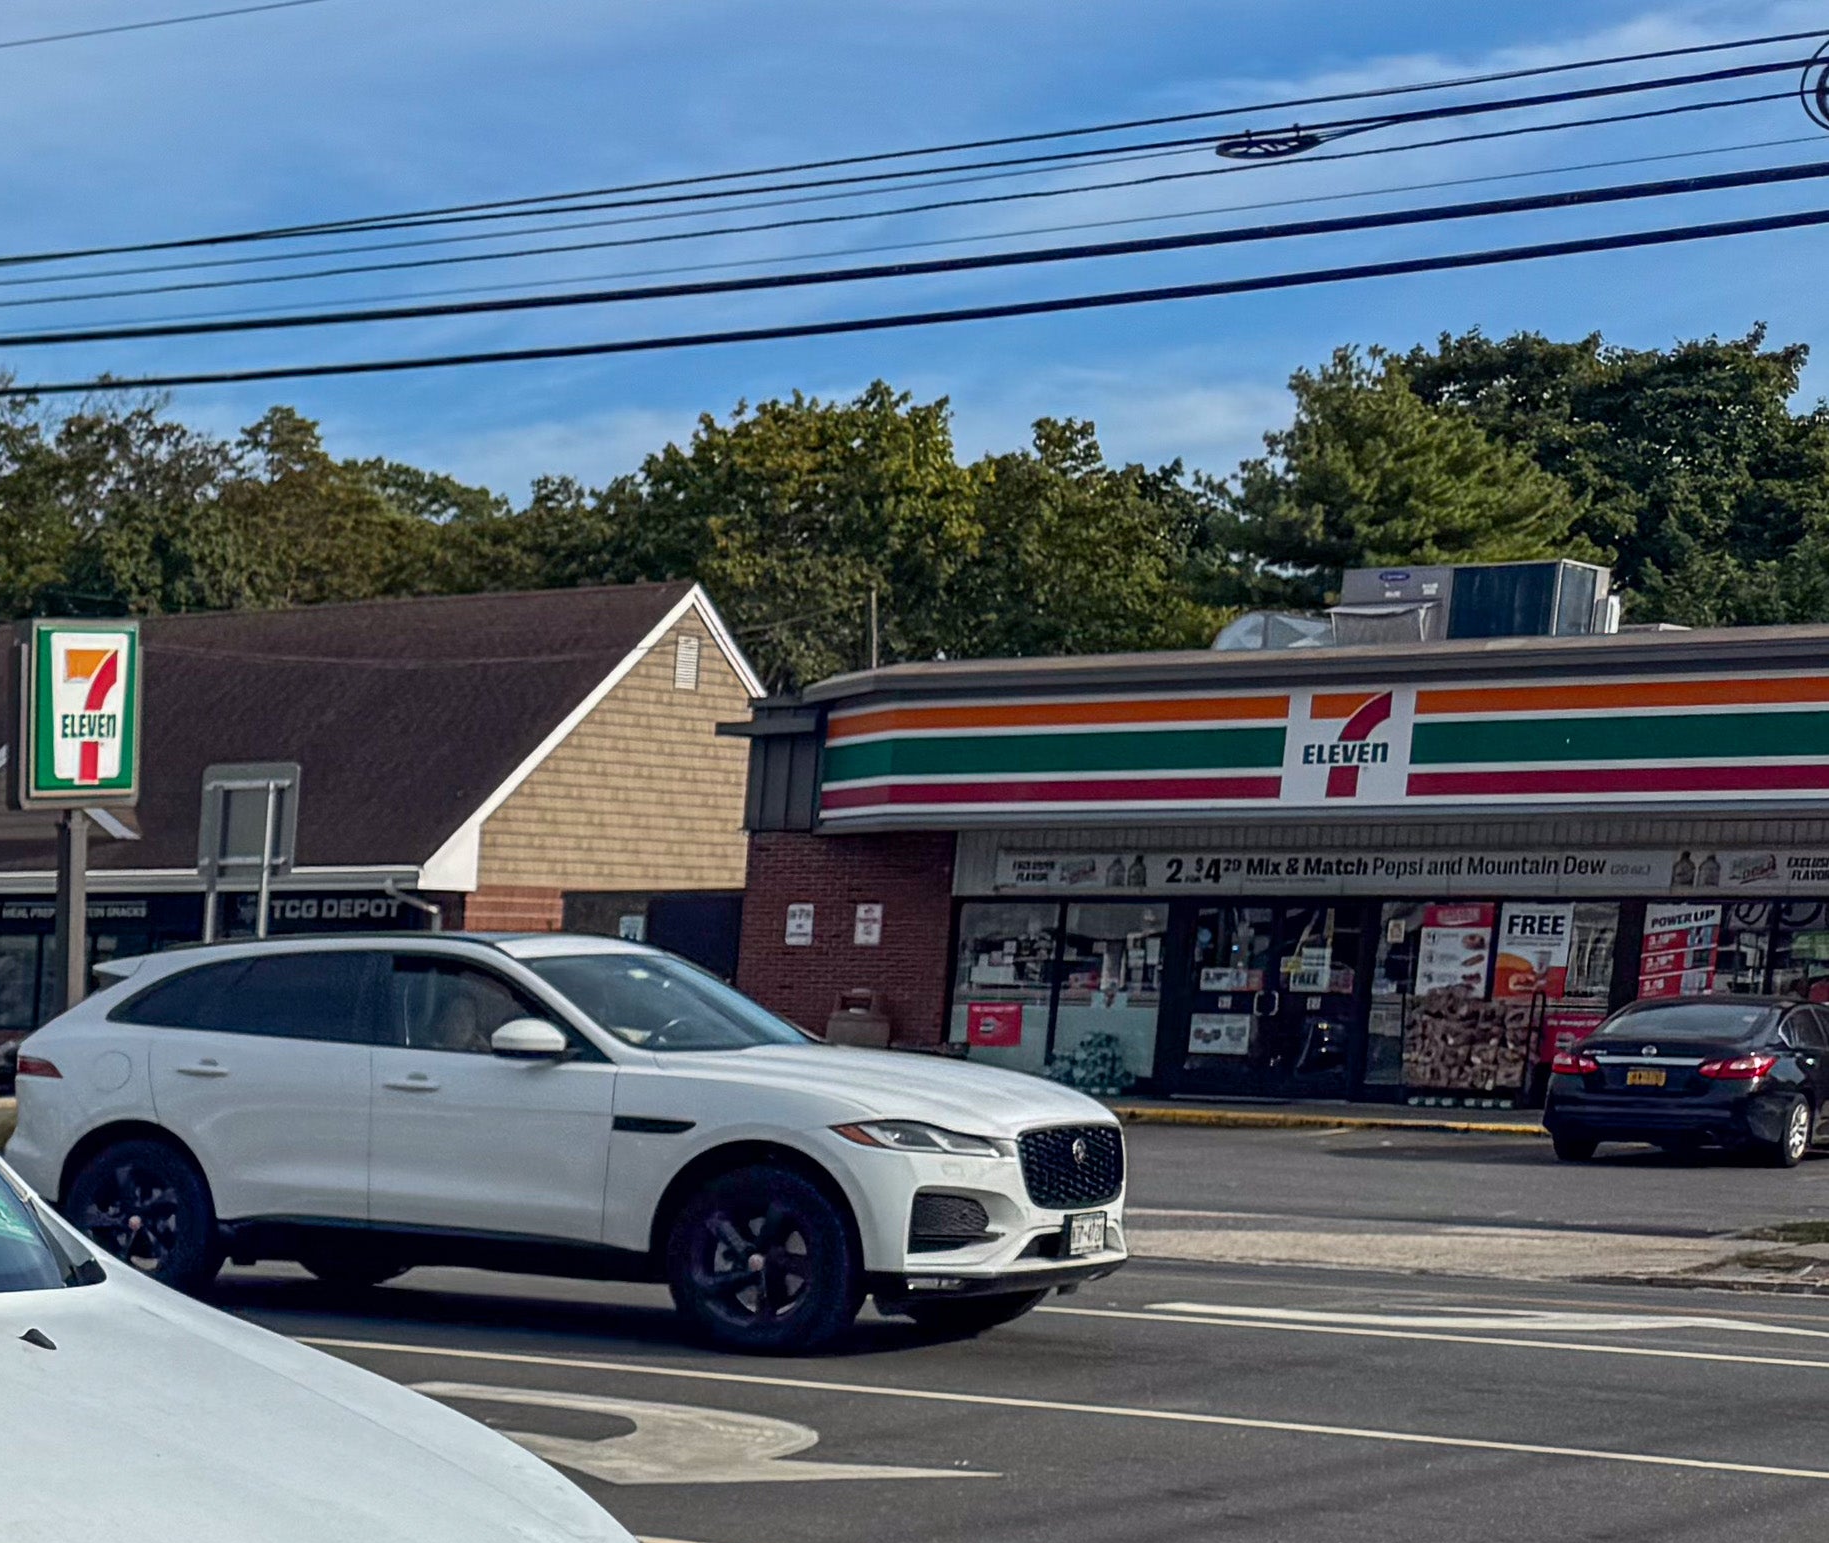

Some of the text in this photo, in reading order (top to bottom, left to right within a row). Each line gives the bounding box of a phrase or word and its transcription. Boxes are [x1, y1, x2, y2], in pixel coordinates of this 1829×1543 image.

[64, 649, 118, 781] 7
[1310, 690, 1392, 798] 7
[1166, 858, 1183, 883] 2
[1246, 857, 1282, 876] Mix
[1286, 857, 1299, 876] &
[1303, 856, 1369, 876] Match
[1373, 856, 1424, 879] Pepsi
[1427, 857, 1462, 876] and
[1467, 855, 1558, 875] Mountain
[1563, 855, 1606, 875] Dew
[271, 899, 402, 919] TCG DEPOT
[1508, 914, 1566, 935] FREE
